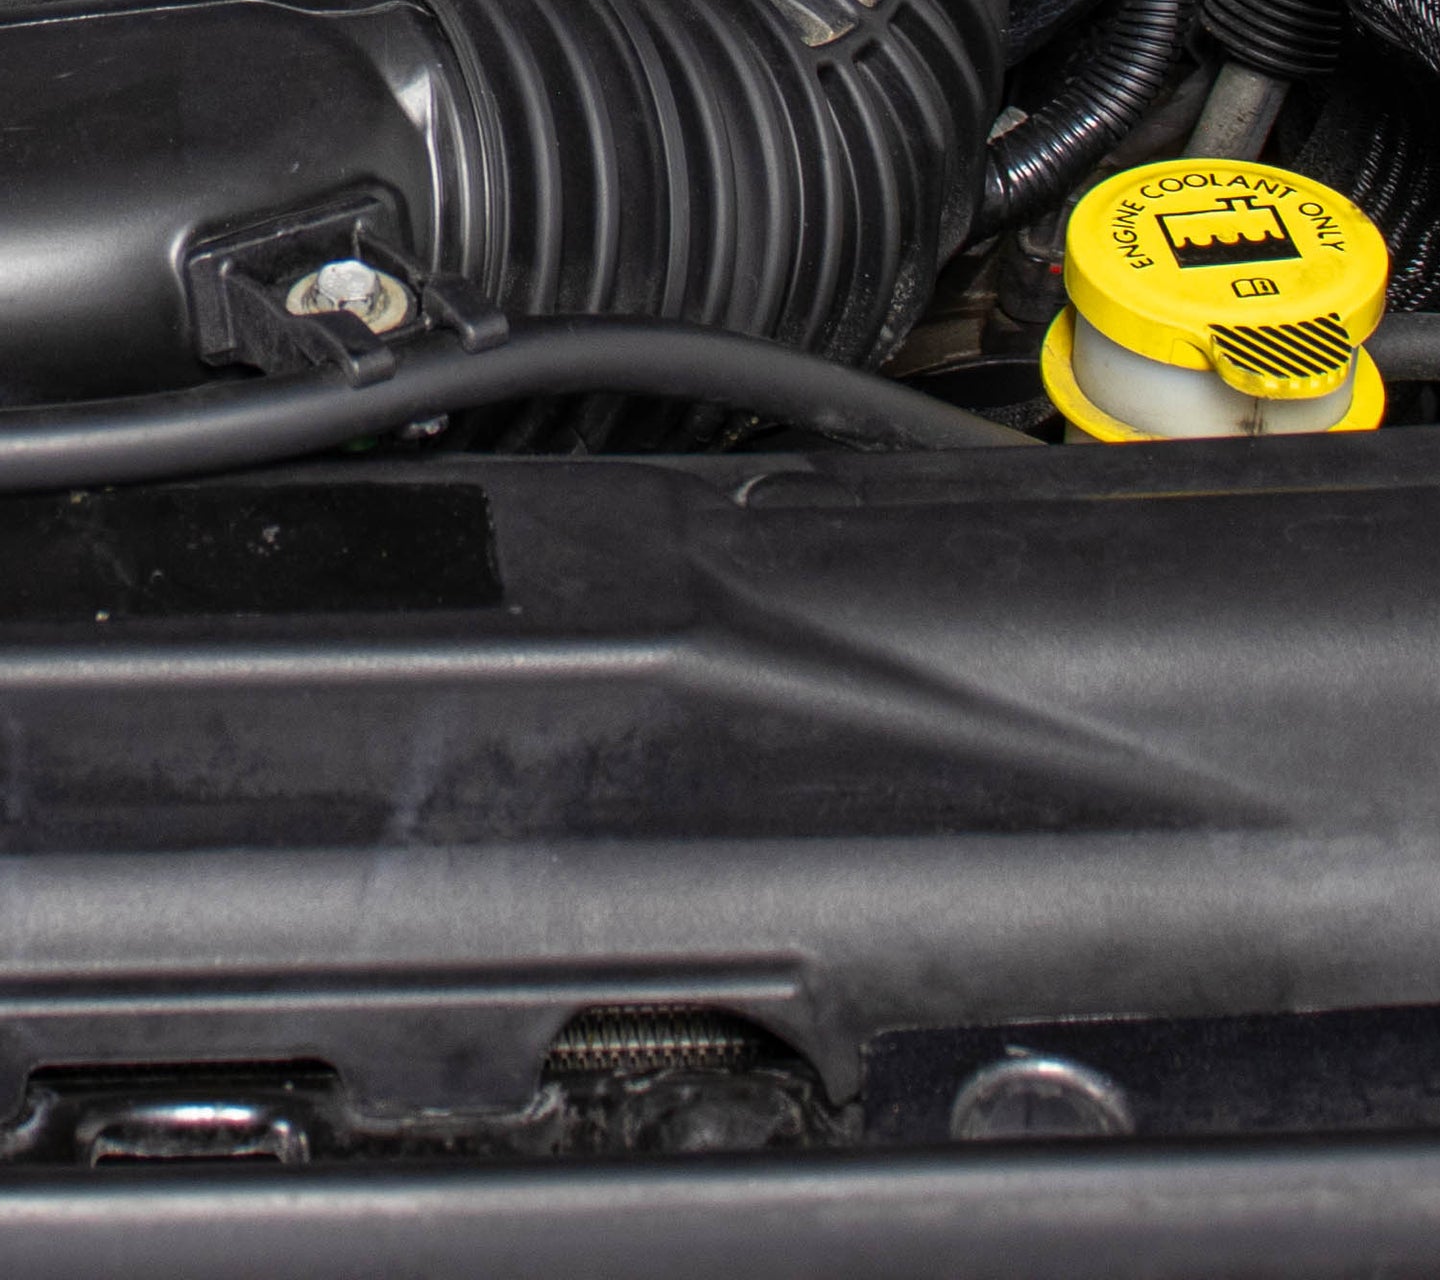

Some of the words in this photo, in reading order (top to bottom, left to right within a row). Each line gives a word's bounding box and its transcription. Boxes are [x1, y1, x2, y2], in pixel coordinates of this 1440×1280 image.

[1112, 199, 1154, 271] ENGINE
[1140, 172, 1298, 200] COOLANT
[1298, 201, 1346, 253] ONLY
